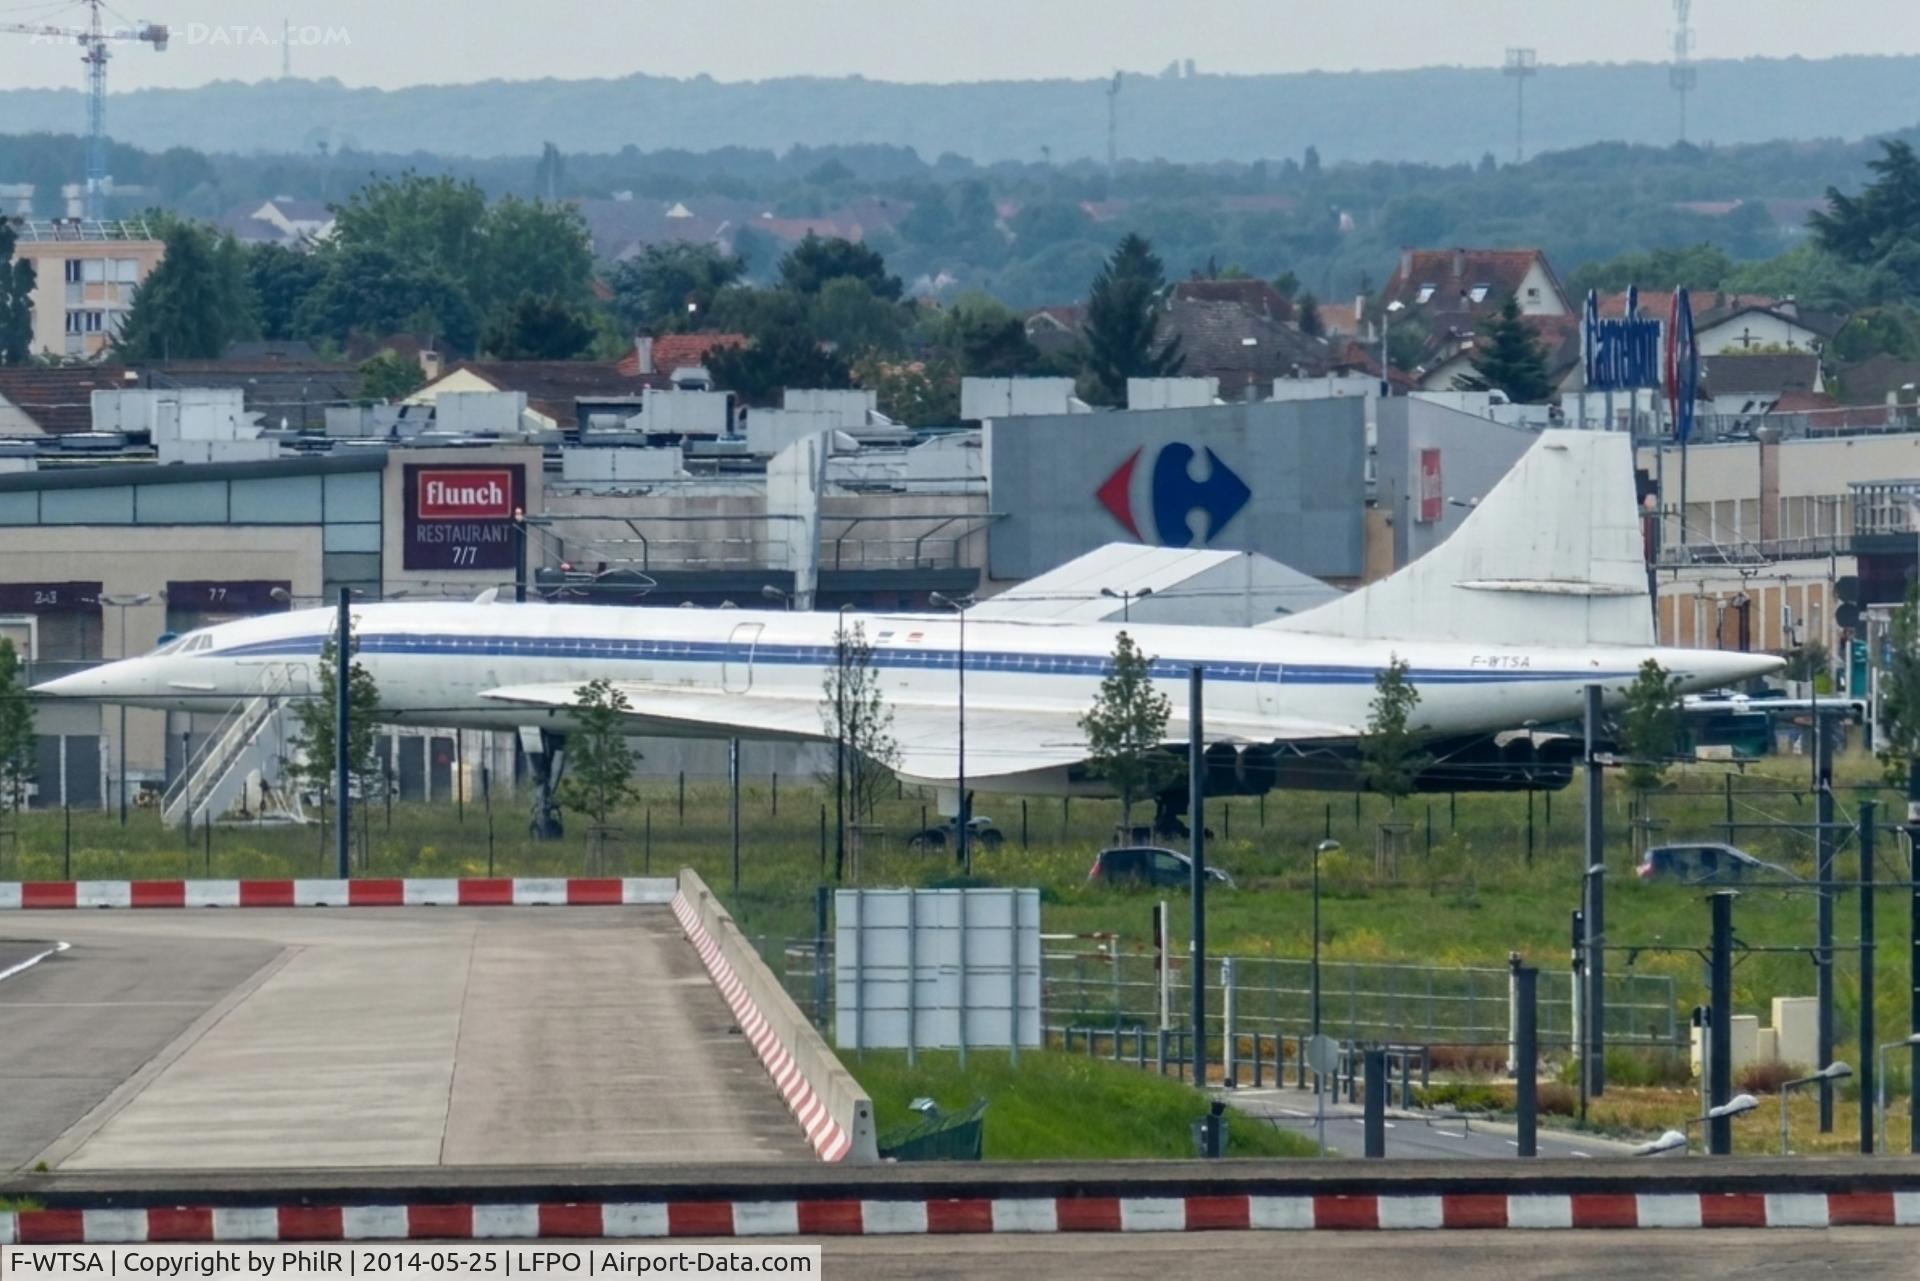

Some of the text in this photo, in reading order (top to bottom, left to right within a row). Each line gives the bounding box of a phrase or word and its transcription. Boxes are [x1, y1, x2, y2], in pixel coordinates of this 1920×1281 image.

[426, 480, 503, 505] flunch
[416, 524, 510, 543] RESTAURANT
[452, 545, 478, 565] 7/7
[1470, 655, 1531, 668] F-WTSA
